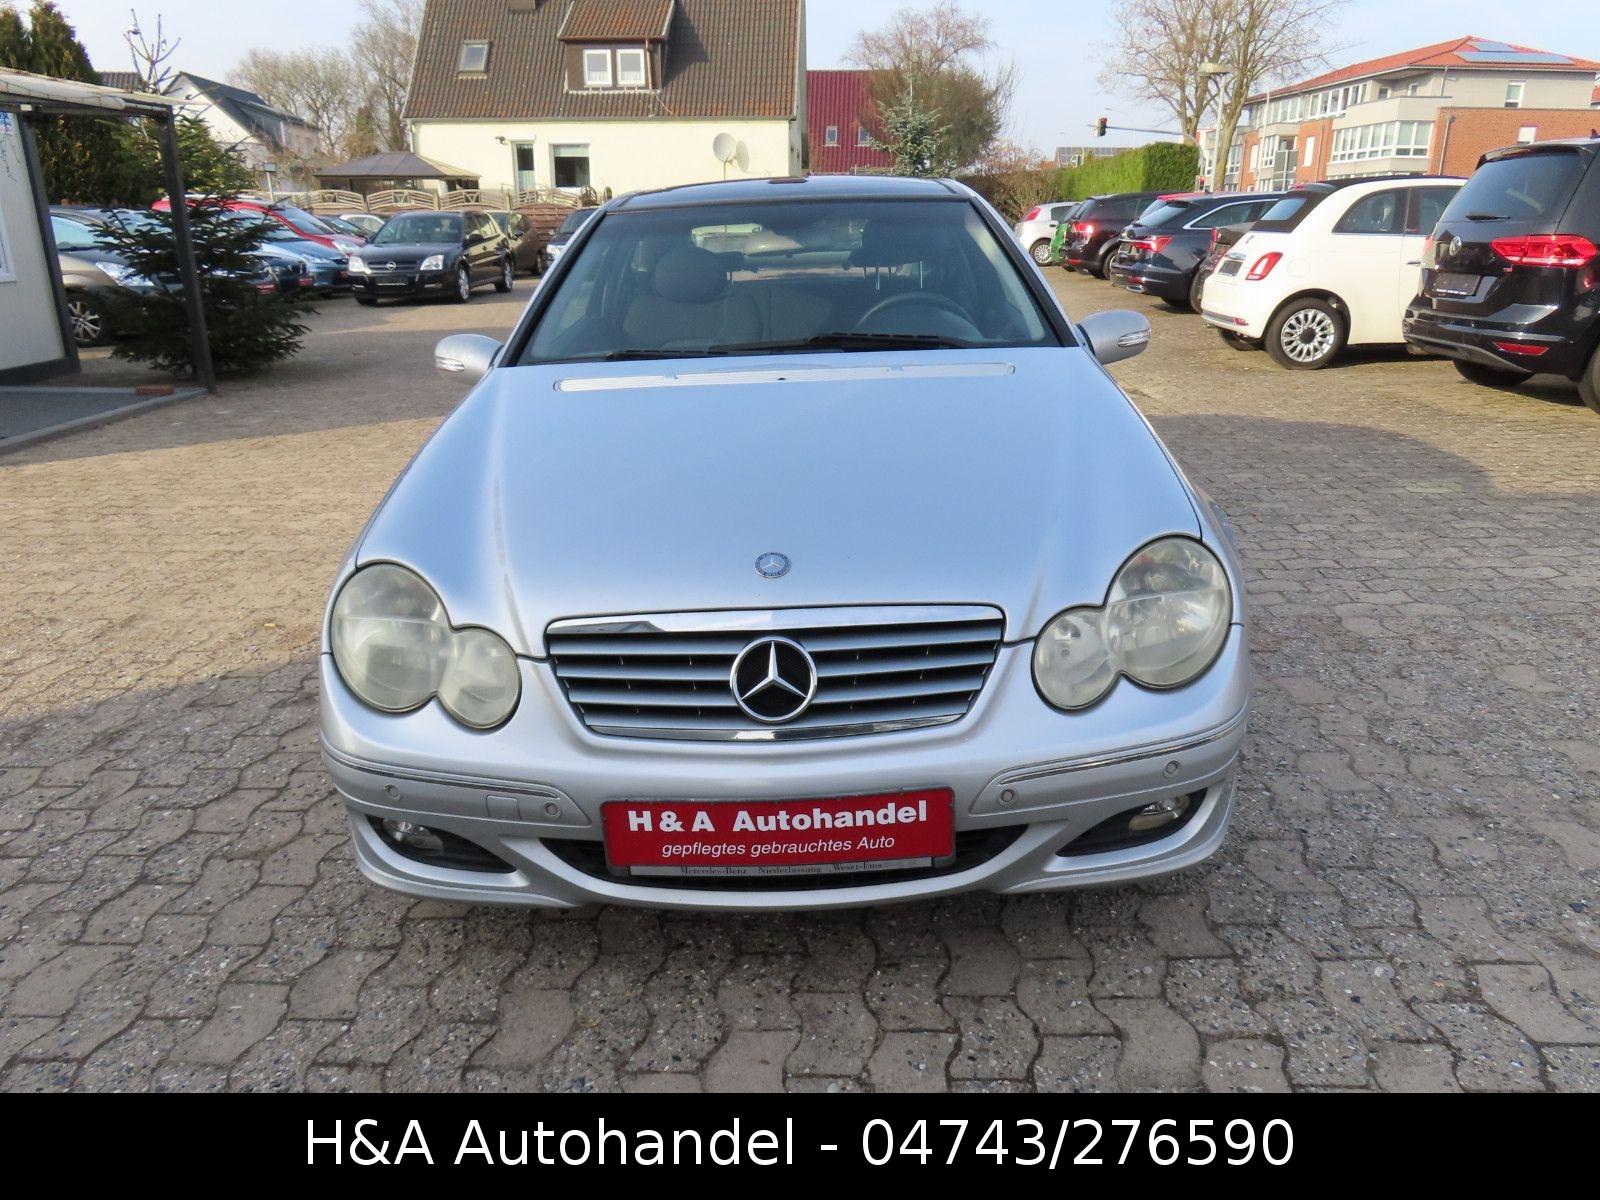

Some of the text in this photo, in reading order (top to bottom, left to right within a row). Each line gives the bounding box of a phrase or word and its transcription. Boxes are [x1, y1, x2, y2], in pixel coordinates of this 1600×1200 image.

[627, 800, 928, 832] H & A Autohandel
[661, 835, 896, 857] gepflegtes gebrauchtes Auto
